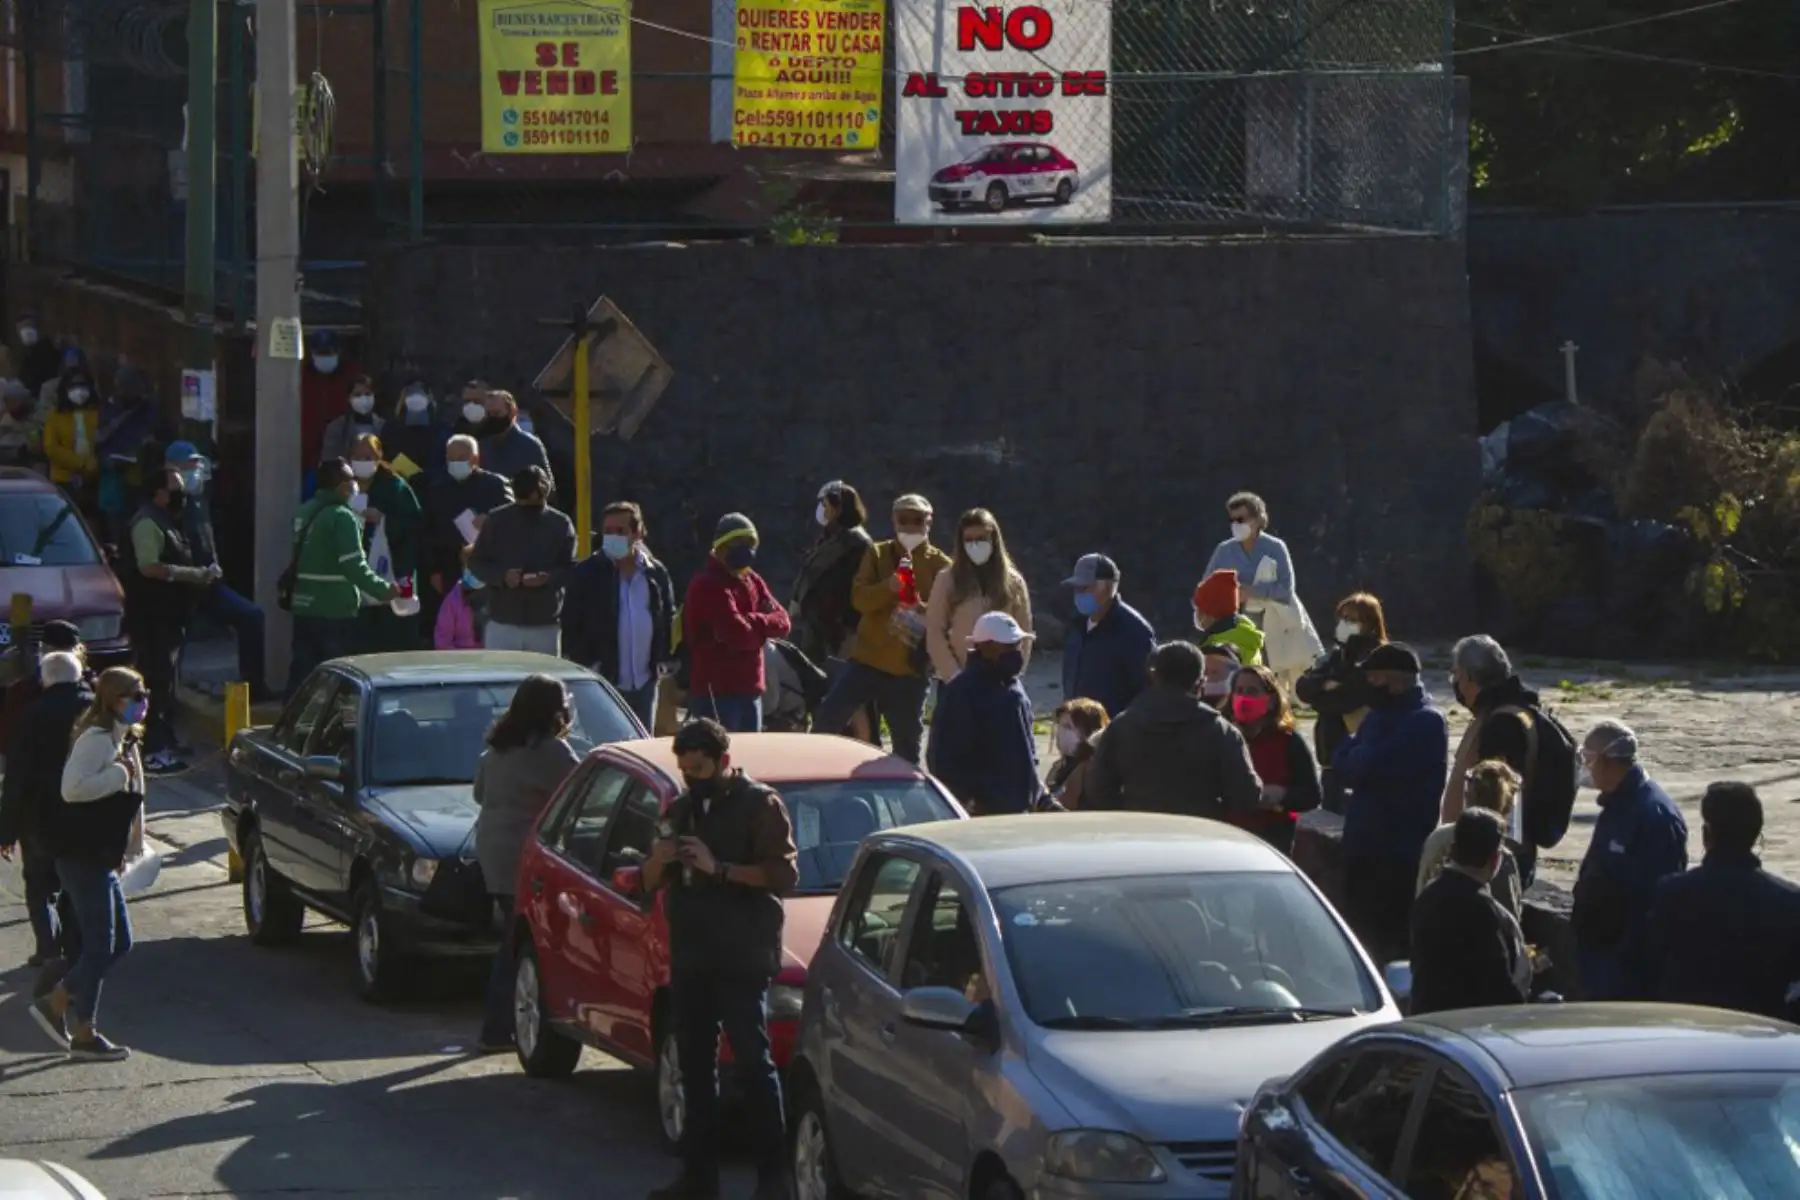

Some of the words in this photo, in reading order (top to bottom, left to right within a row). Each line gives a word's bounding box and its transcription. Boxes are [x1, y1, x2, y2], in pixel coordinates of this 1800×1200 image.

[738, 9, 810, 29] QUIERES
[816, 11, 882, 31] VENDER
[957, 5, 1054, 52] NO
[751, 32, 812, 52] RENTAR
[816, 33, 837, 53] TU
[841, 34, 882, 54] CASA
[535, 42, 581, 68] SE
[788, 55, 857, 69] DEPTO
[497, 70, 619, 96] VENDE
[902, 72, 948, 97] AL
[964, 72, 1054, 97] SITIO
[1061, 70, 1107, 96] DE
[522, 110, 610, 125] 5510417014
[735, 108, 865, 129] Cel:5591101110
[955, 109, 1054, 135] TAXIS
[522, 130, 610, 145] 5591101110
[736, 131, 844, 147] 10417014
